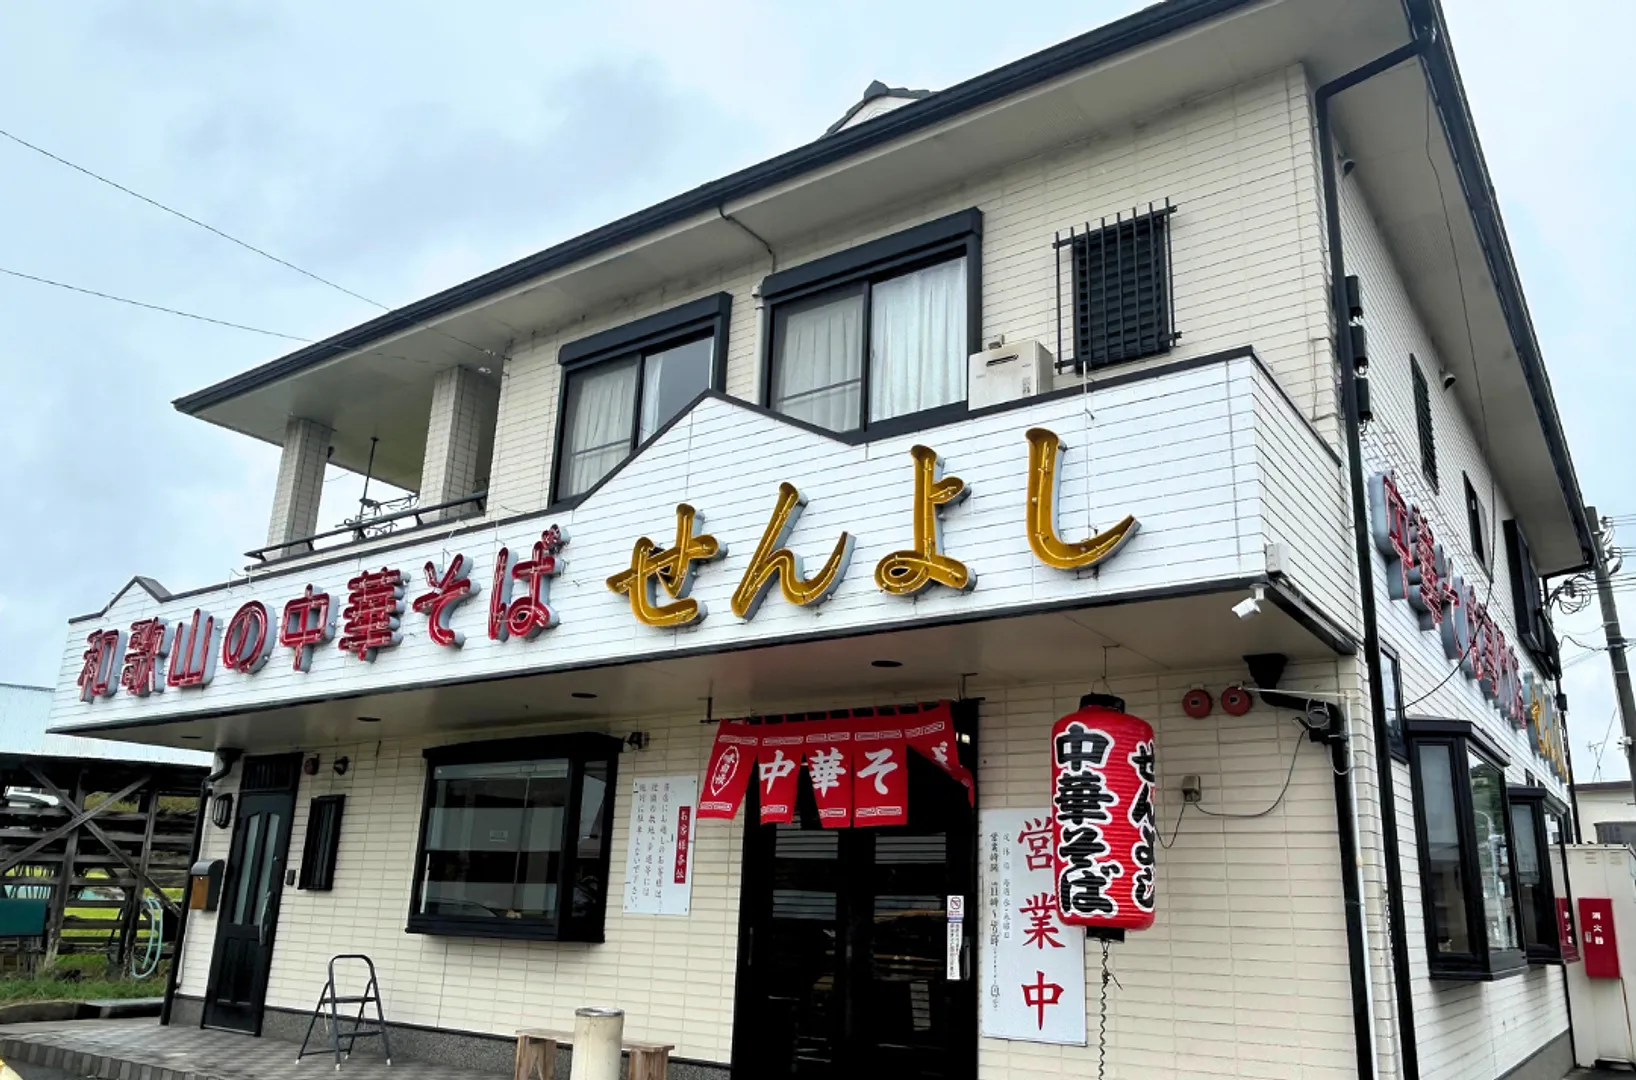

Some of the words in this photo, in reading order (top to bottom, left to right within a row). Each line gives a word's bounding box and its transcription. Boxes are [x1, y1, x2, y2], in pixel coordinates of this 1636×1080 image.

[77, 524, 568, 703] 和歌山の中華そば
[606, 427, 1141, 628] せんよし
[1054, 723, 1121, 917] 中華そば
[1017, 816, 1066, 1031] 営業中
